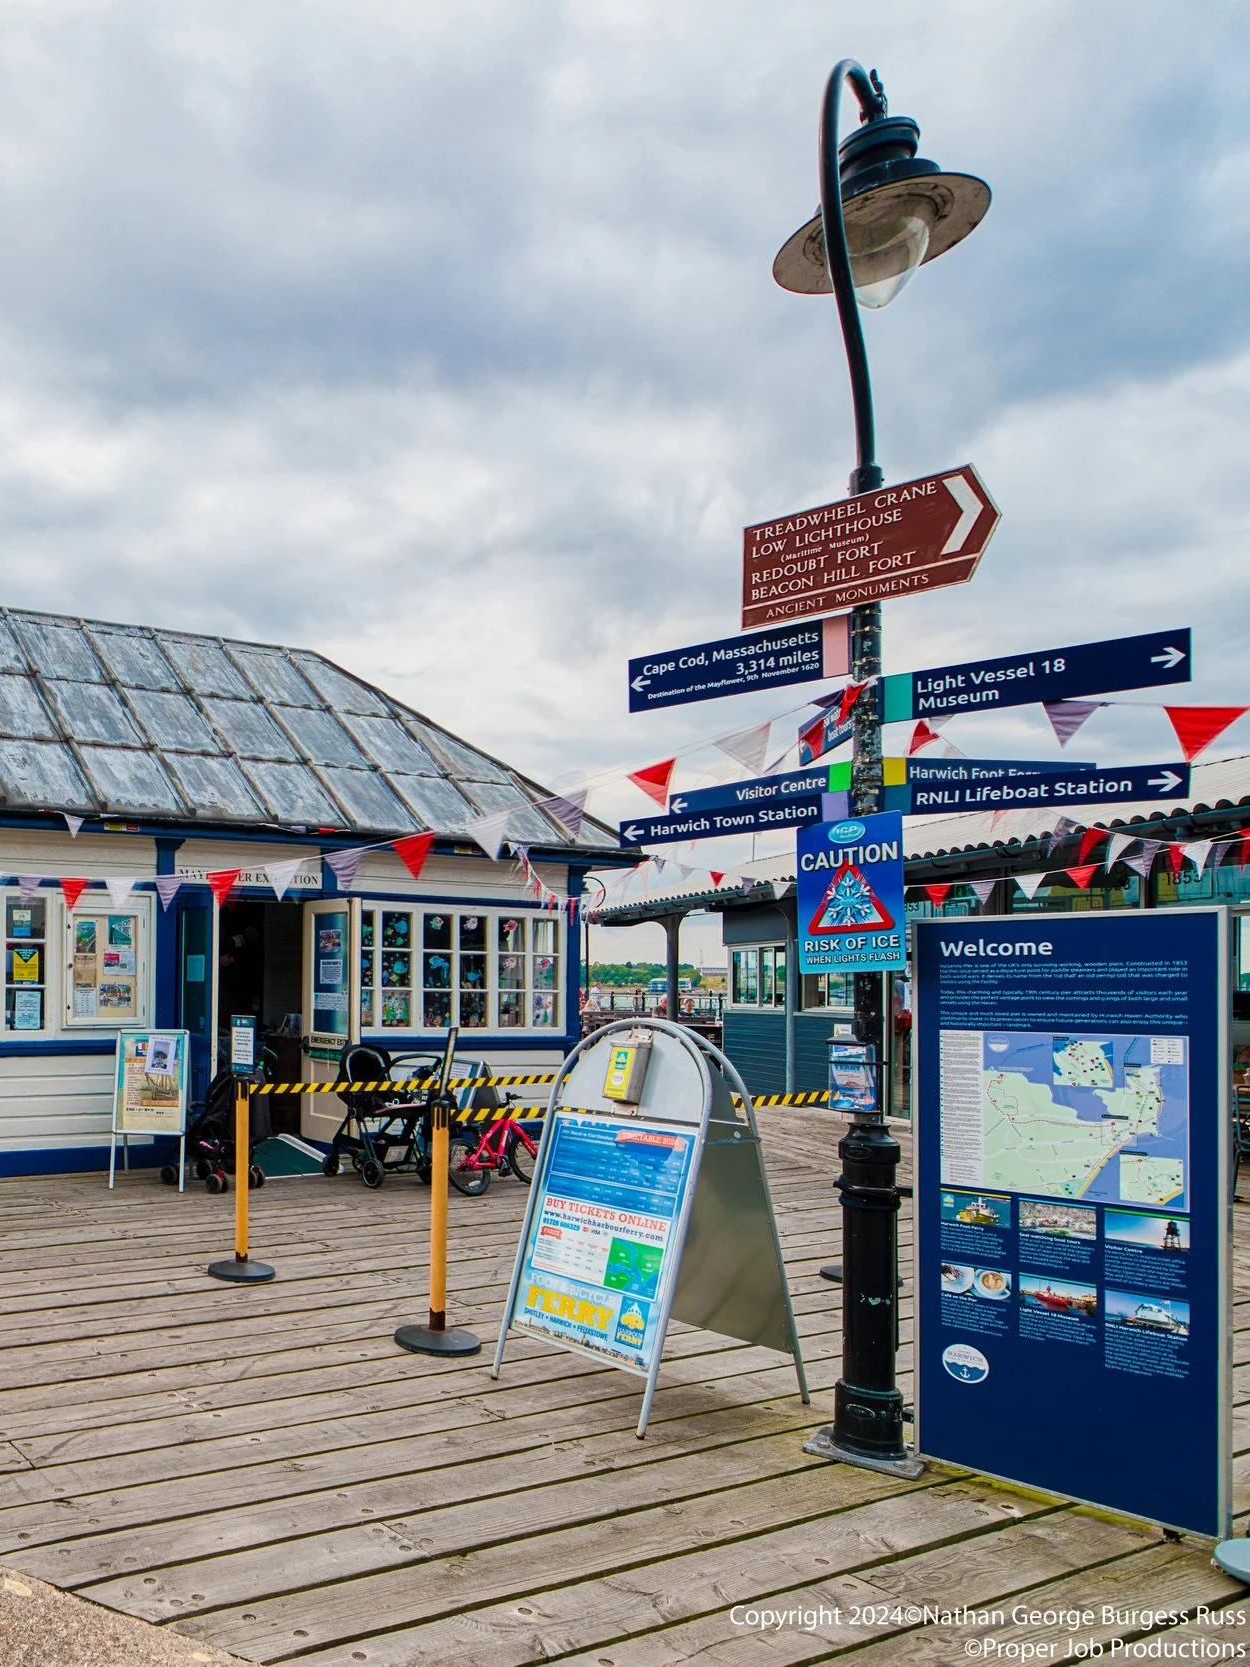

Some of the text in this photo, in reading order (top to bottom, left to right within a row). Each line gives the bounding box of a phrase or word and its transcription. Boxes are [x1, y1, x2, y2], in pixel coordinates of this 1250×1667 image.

[753, 481, 937, 541] TREADWHEEL CRANE
[752, 509, 903, 558] LOW LIGHTHOUSE
[781, 533, 870, 563] (Maritime Museum)
[751, 542, 883, 584] REDOUBT FORT
[751, 551, 916, 601] BEACON HILL FORT
[766, 573, 929, 619] ANCIENT MONUMENTS
[643, 632, 819, 676] Cape Cod, Massachusetts
[736, 650, 819, 675] 3,314 miles
[648, 688, 685, 699] Destination
[695, 683, 706, 691] the
[707, 676, 745, 689] Mayflower,
[747, 674, 758, 682] 9th
[762, 667, 799, 679] November
[801, 662, 820, 671] 1620
[917, 658, 1066, 694] Light Vessel 18
[919, 688, 999, 711] Museum
[909, 766, 968, 780] Harwich
[971, 768, 1005, 778] Foot
[736, 777, 826, 801] Visitor Centre
[916, 778, 1133, 805] RNLI Lifeboat Station
[651, 805, 817, 836] Harwich Town Station
[801, 841, 898, 872] CAUTION
[804, 935, 899, 952] RISK OF ICE
[806, 952, 900, 964] WHEN LIGHTS FLASH
[940, 938, 1053, 957] Welcome
[311, 1036, 336, 1045] EMERGENCY
[623, 1131, 679, 1146] TIMETABLE 2024
[543, 1217, 559, 1227] 01728
[544, 1210, 663, 1242] www.harwichharbourferry.com
[546, 1197, 667, 1232] BUY TICKETS ONLINE
[525, 1285, 614, 1331] FERRY
[524, 1307, 608, 1341] SHOTLEY HARWICH FELIXSTOWE
[616, 1333, 643, 1346] FERRY
[947, 1350, 983, 1363] HARWICH
